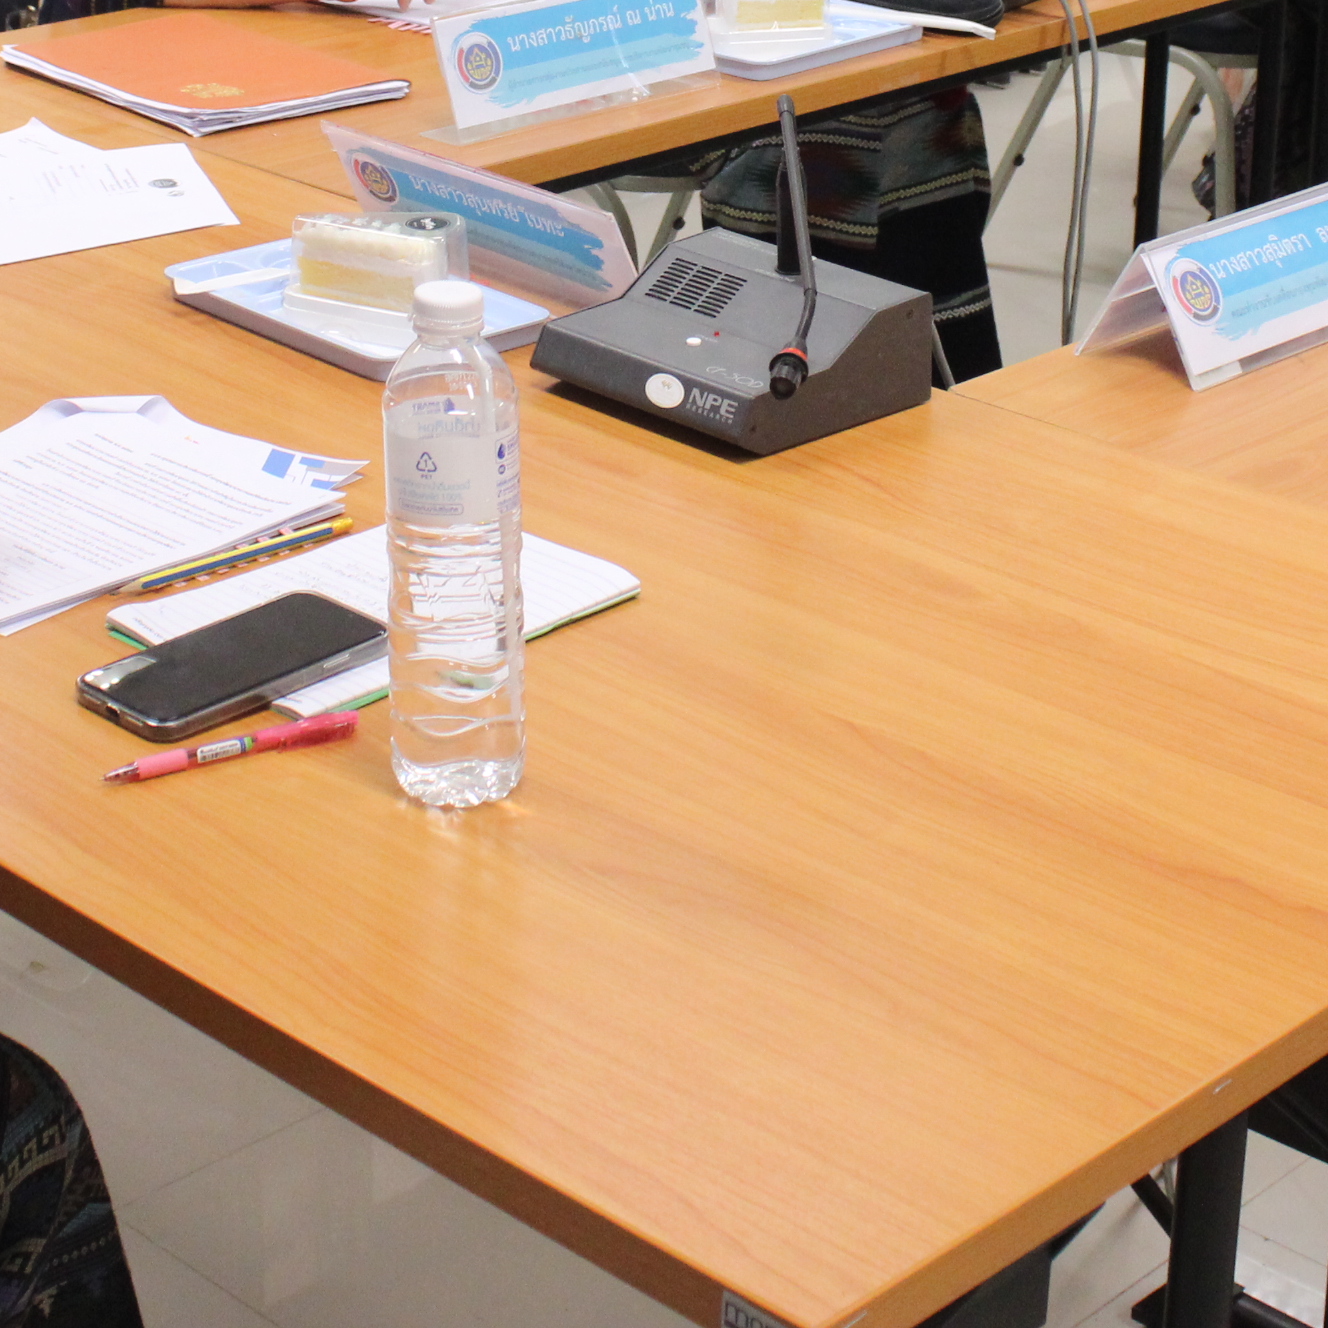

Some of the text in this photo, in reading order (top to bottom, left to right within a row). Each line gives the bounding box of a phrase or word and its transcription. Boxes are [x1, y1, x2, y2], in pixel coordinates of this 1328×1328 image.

[627, 9, 642, 26] ณ
[645, 0, 675, 22] น่าน
[1210, 232, 1312, 279] นางสาวสุมิตรา
[686, 403, 733, 425] RESEARCH
[687, 388, 738, 418] NPE
